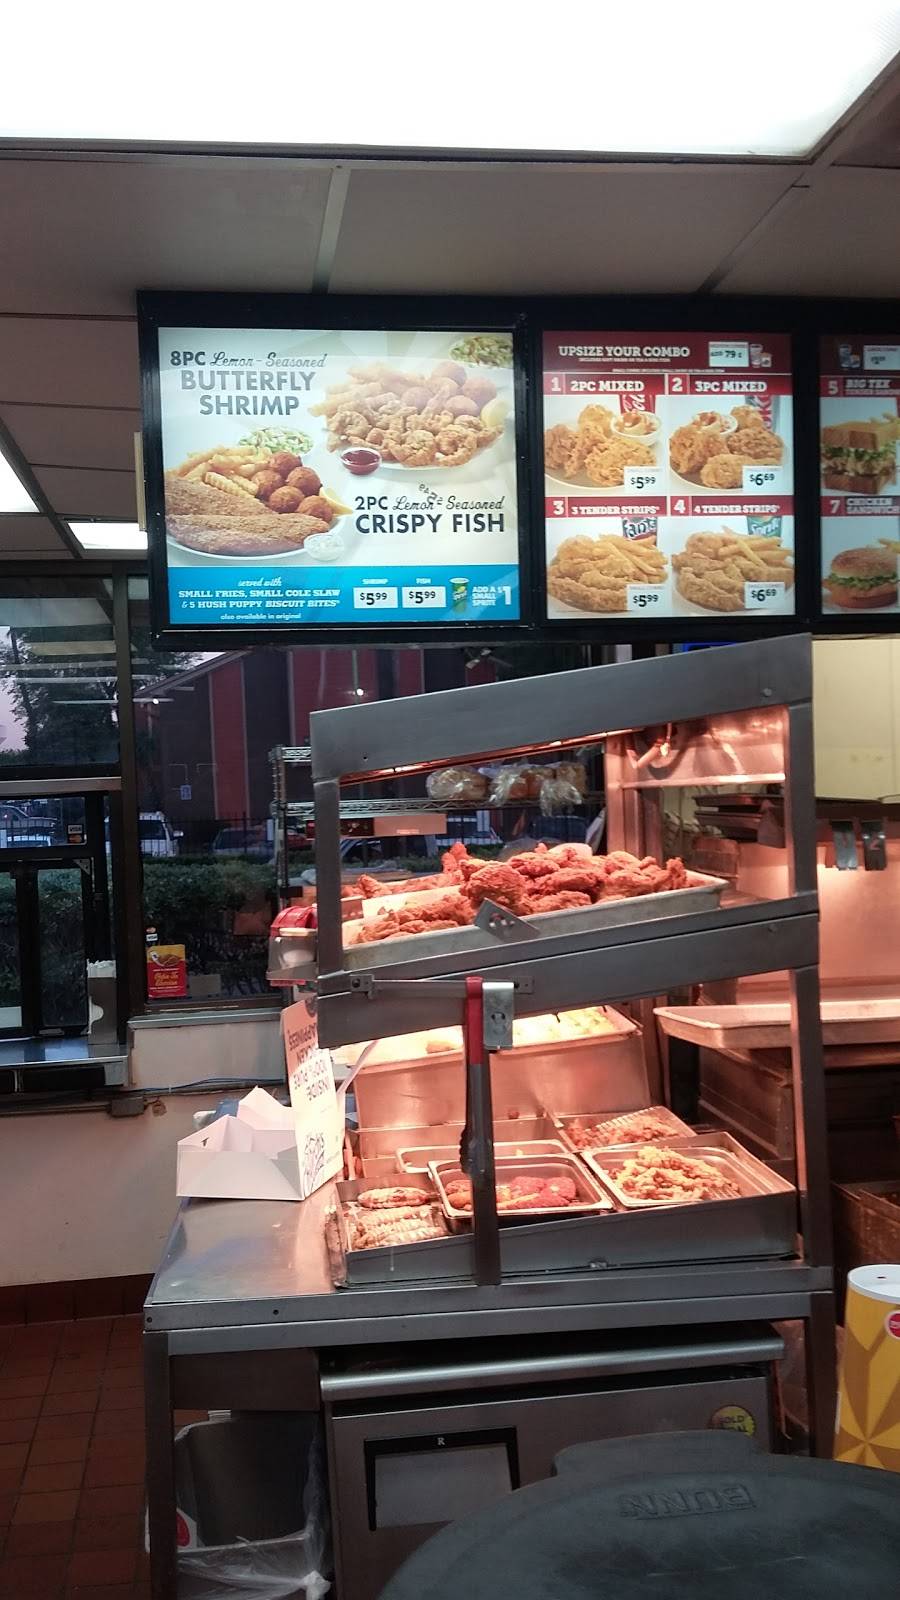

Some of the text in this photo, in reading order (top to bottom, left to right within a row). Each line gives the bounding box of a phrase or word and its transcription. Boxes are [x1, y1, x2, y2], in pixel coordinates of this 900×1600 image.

[170, 351, 206, 366] 8PC
[558, 346, 690, 357] UPSIZE YOUR COMBO
[181, 370, 316, 391] BUTTERFLY
[551, 377, 561, 391] 1
[571, 381, 645, 392] 2PC MIXED
[672, 377, 683, 392] 2
[695, 381, 768, 392] 3PC MIXED
[828, 381, 838, 395] 5
[200, 395, 300, 416] SHRIMP
[354, 496, 388, 511] 2PC
[553, 500, 564, 515] 3
[580, 506, 620, 515] TENDER
[674, 499, 685, 514] 4
[702, 505, 742, 514] TENDER
[355, 513, 505, 534] CRISPY FISH
[178, 589, 341, 598] SMALL FRIES, SMALL COLE SLAW
[198, 601, 227, 609] HUSH
[229, 600, 263, 608] PUPPY
[265, 600, 306, 608] BISCUIT
